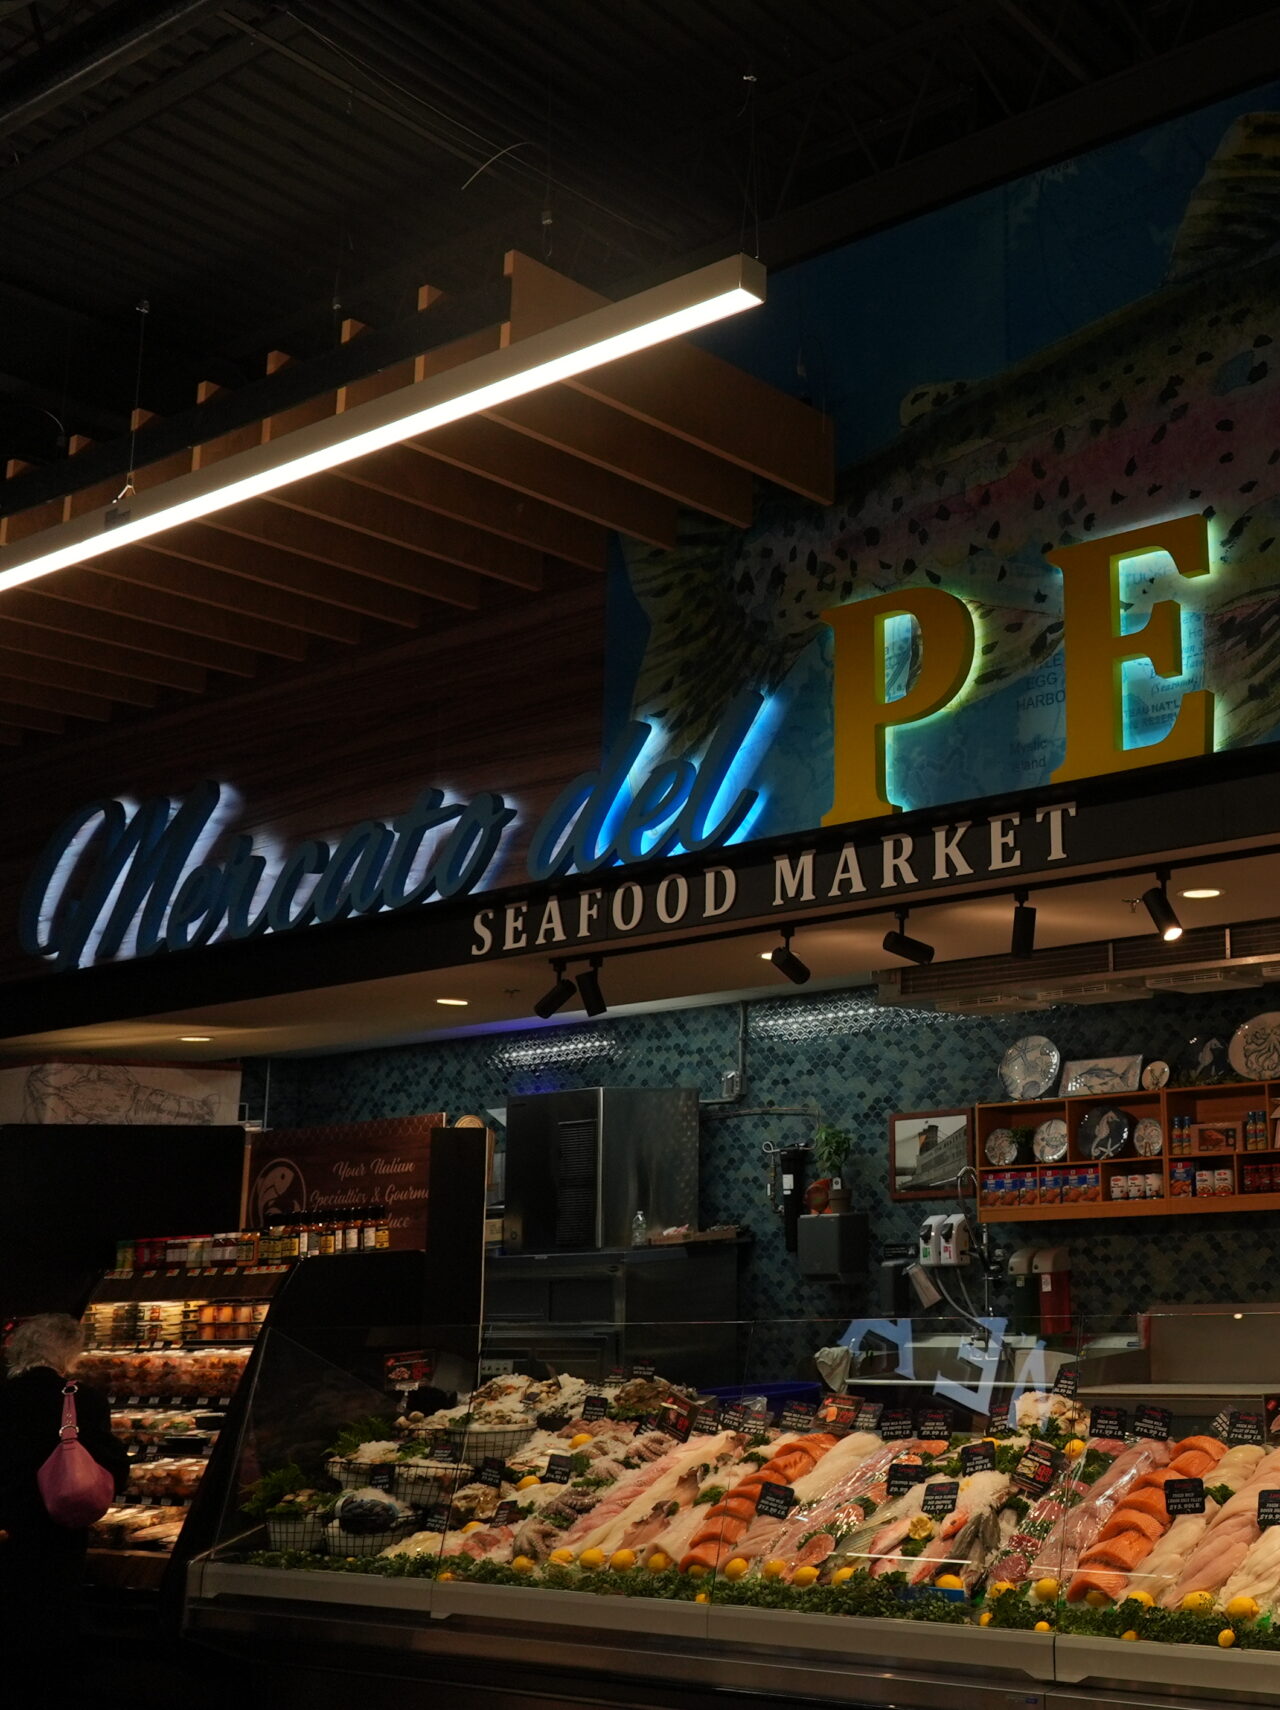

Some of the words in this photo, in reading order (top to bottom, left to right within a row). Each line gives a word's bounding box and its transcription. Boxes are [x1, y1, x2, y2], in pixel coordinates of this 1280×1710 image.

[1015, 689, 1066, 713] HARBO
[20, 778, 518, 974] Mercato
[527, 690, 765, 881] del
[471, 865, 739, 957] SEAFOOD
[772, 800, 1079, 907] MARKET
[333, 1159, 366, 1181] Your
[370, 1156, 415, 1176] Italian
[310, 1189, 367, 1209] Specialties
